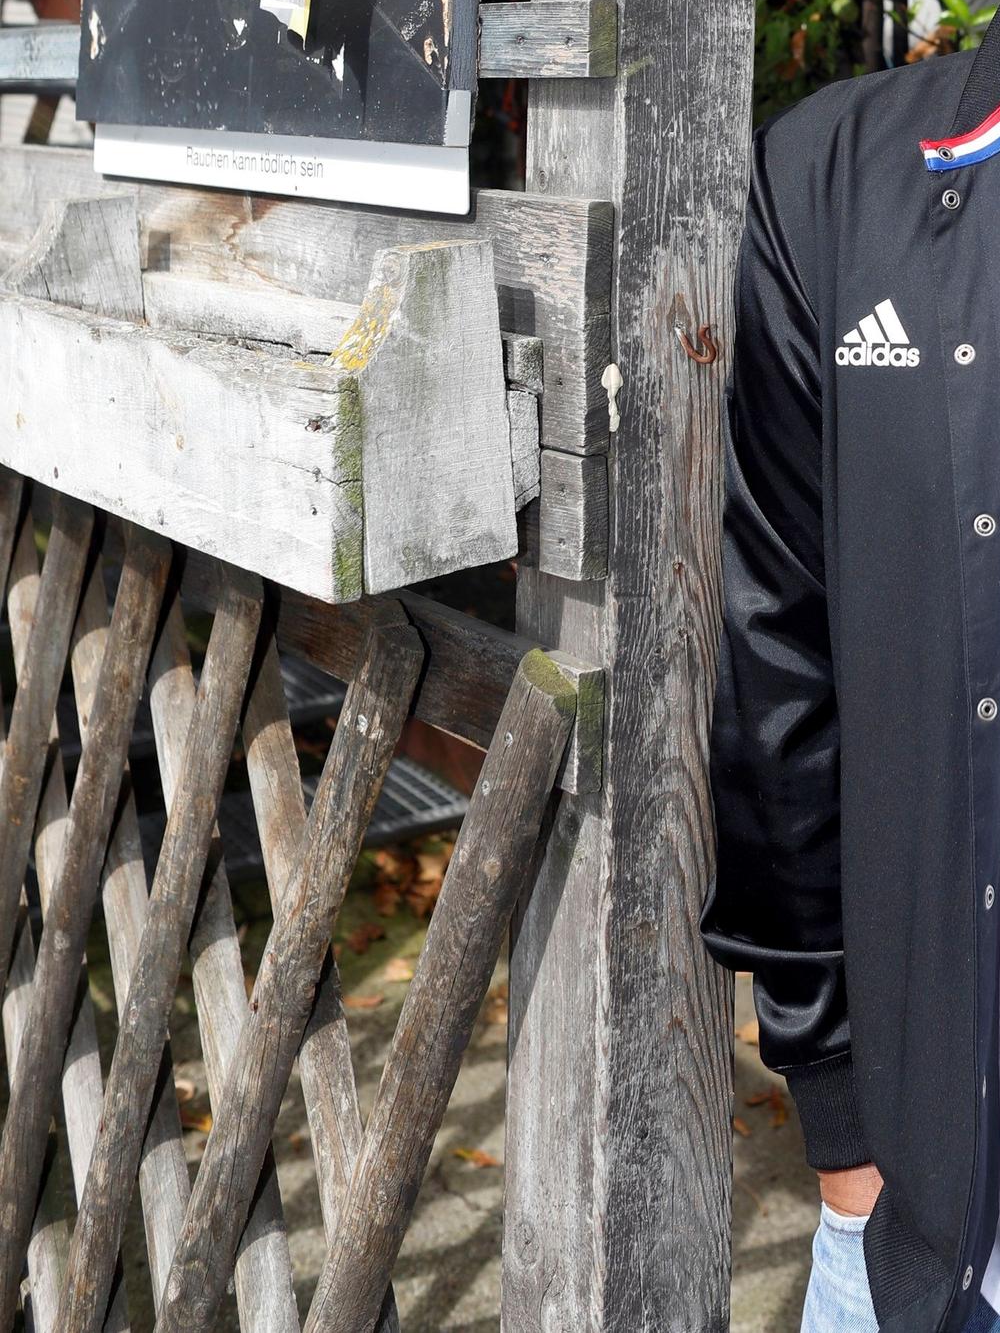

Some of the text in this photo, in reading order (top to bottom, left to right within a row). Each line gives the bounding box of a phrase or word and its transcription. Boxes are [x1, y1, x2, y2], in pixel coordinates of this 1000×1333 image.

[186, 146, 324, 178] Rauchen kann tödlich sein
[835, 341, 920, 367] adidas
